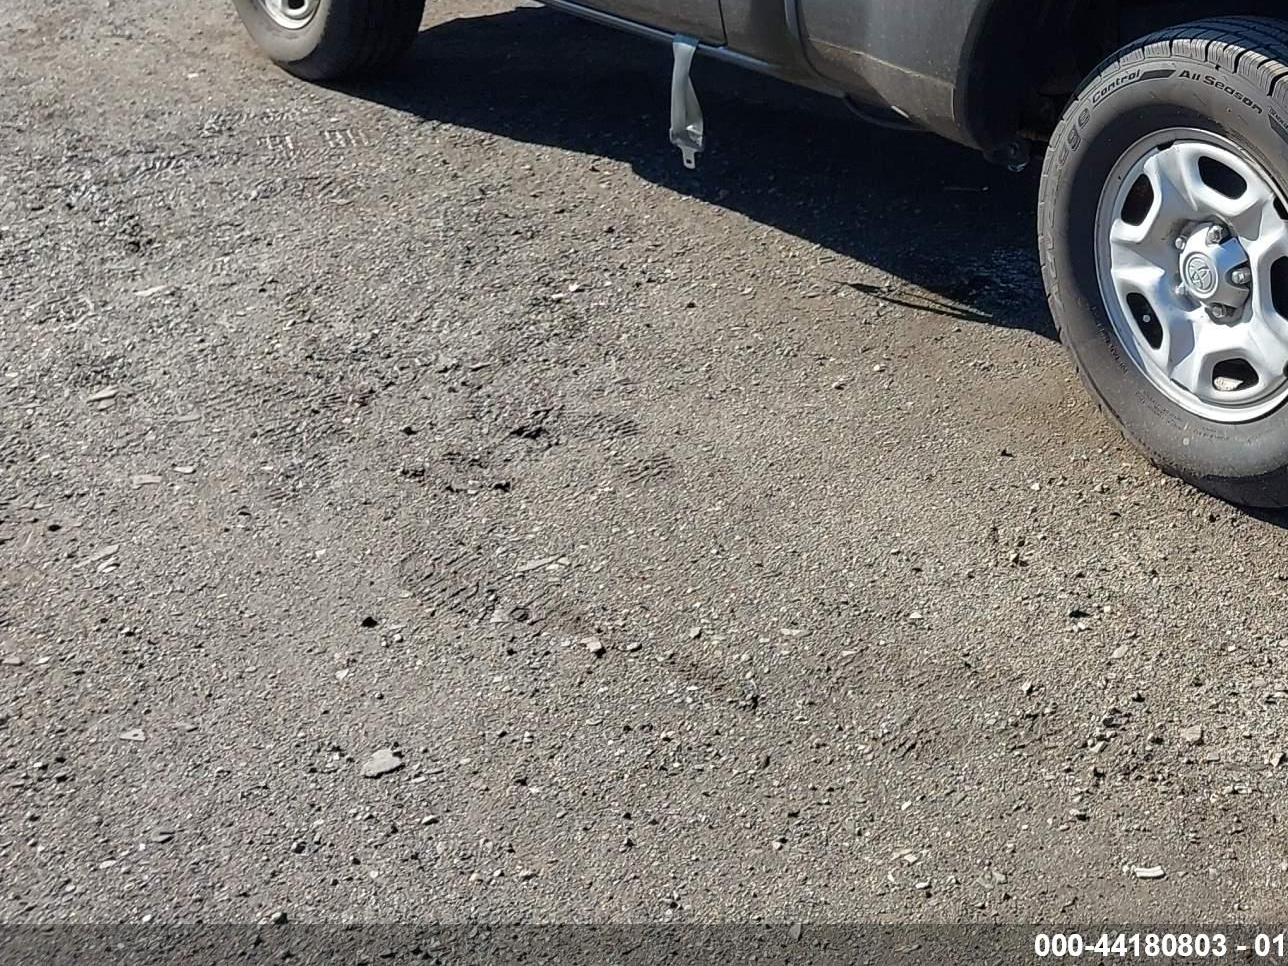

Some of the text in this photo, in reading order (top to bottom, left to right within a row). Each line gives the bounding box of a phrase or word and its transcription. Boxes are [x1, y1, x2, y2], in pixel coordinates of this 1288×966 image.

[1091, 68, 1141, 105] Control
[1178, 69, 1201, 82] All
[1202, 74, 1263, 115] Season
